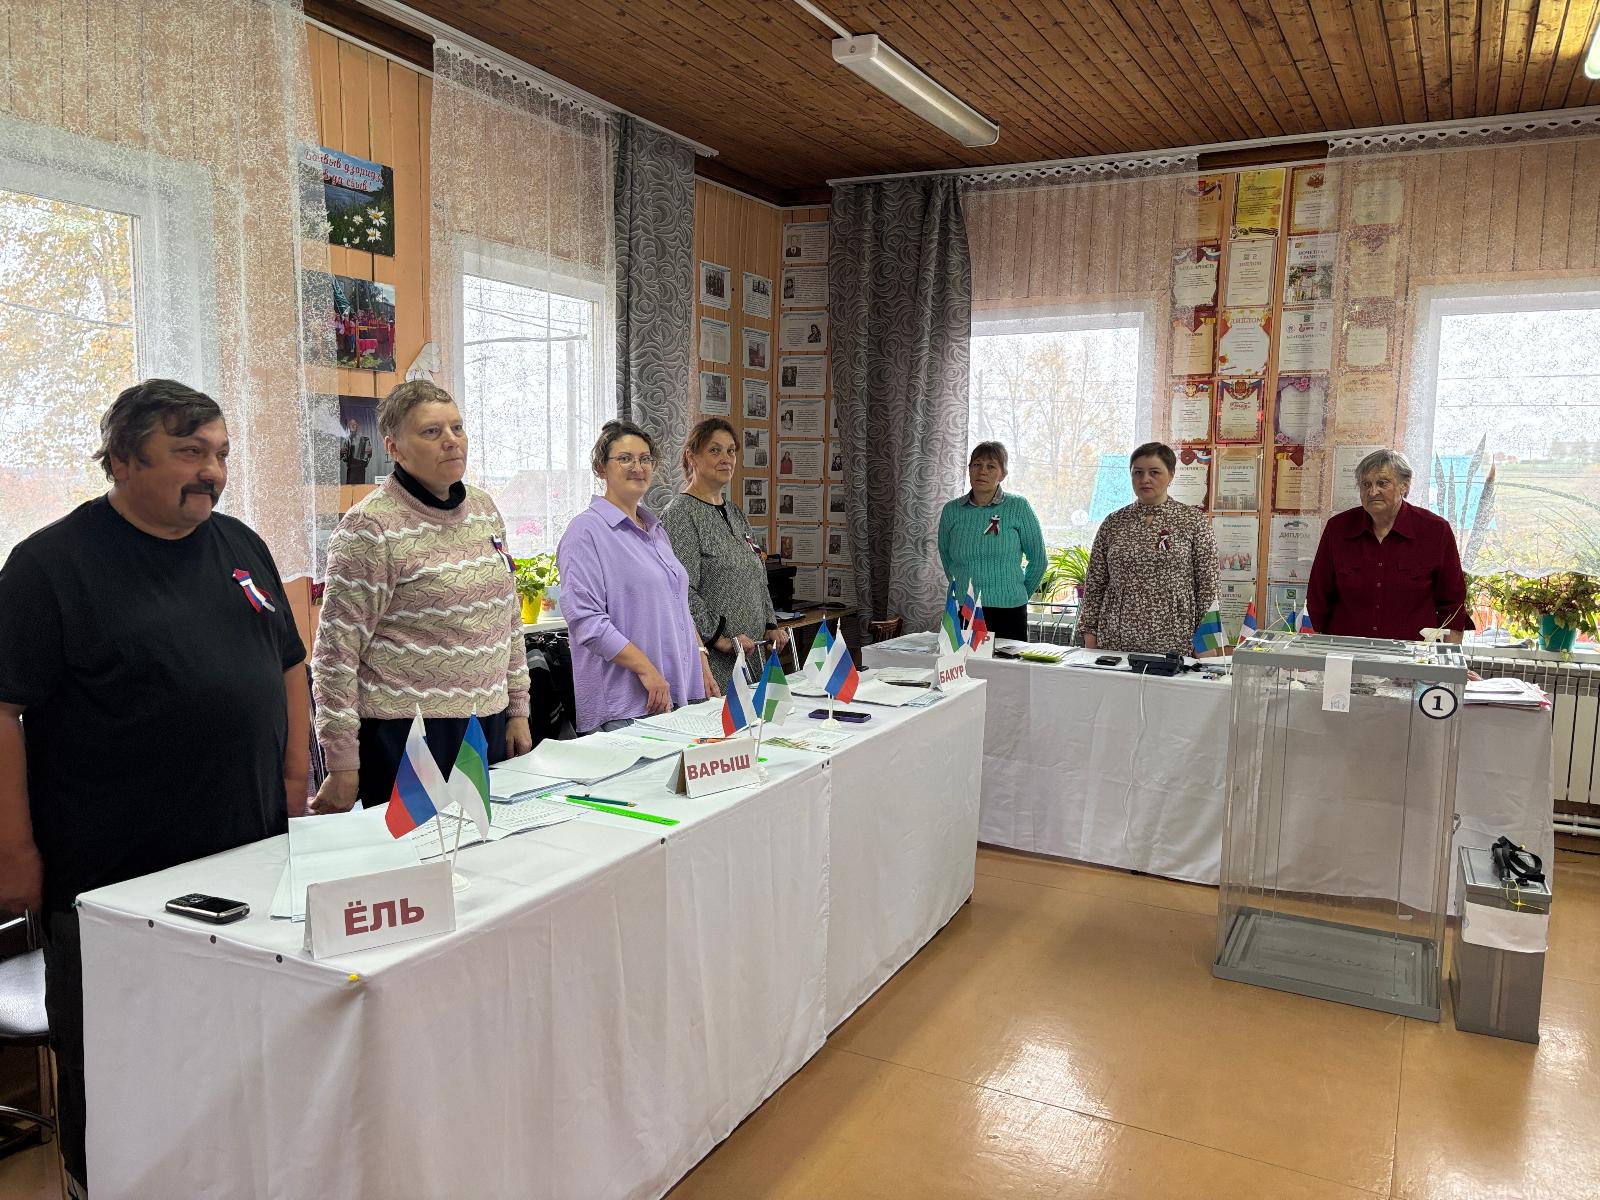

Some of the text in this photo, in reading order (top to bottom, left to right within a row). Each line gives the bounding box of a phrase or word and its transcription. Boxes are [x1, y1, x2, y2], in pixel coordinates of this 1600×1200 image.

[940, 665, 964, 683] БАКУР
[1432, 695, 1443, 711] 1
[687, 754, 750, 780] ВАРЫШ
[344, 898, 425, 936] ЁЛЬ
